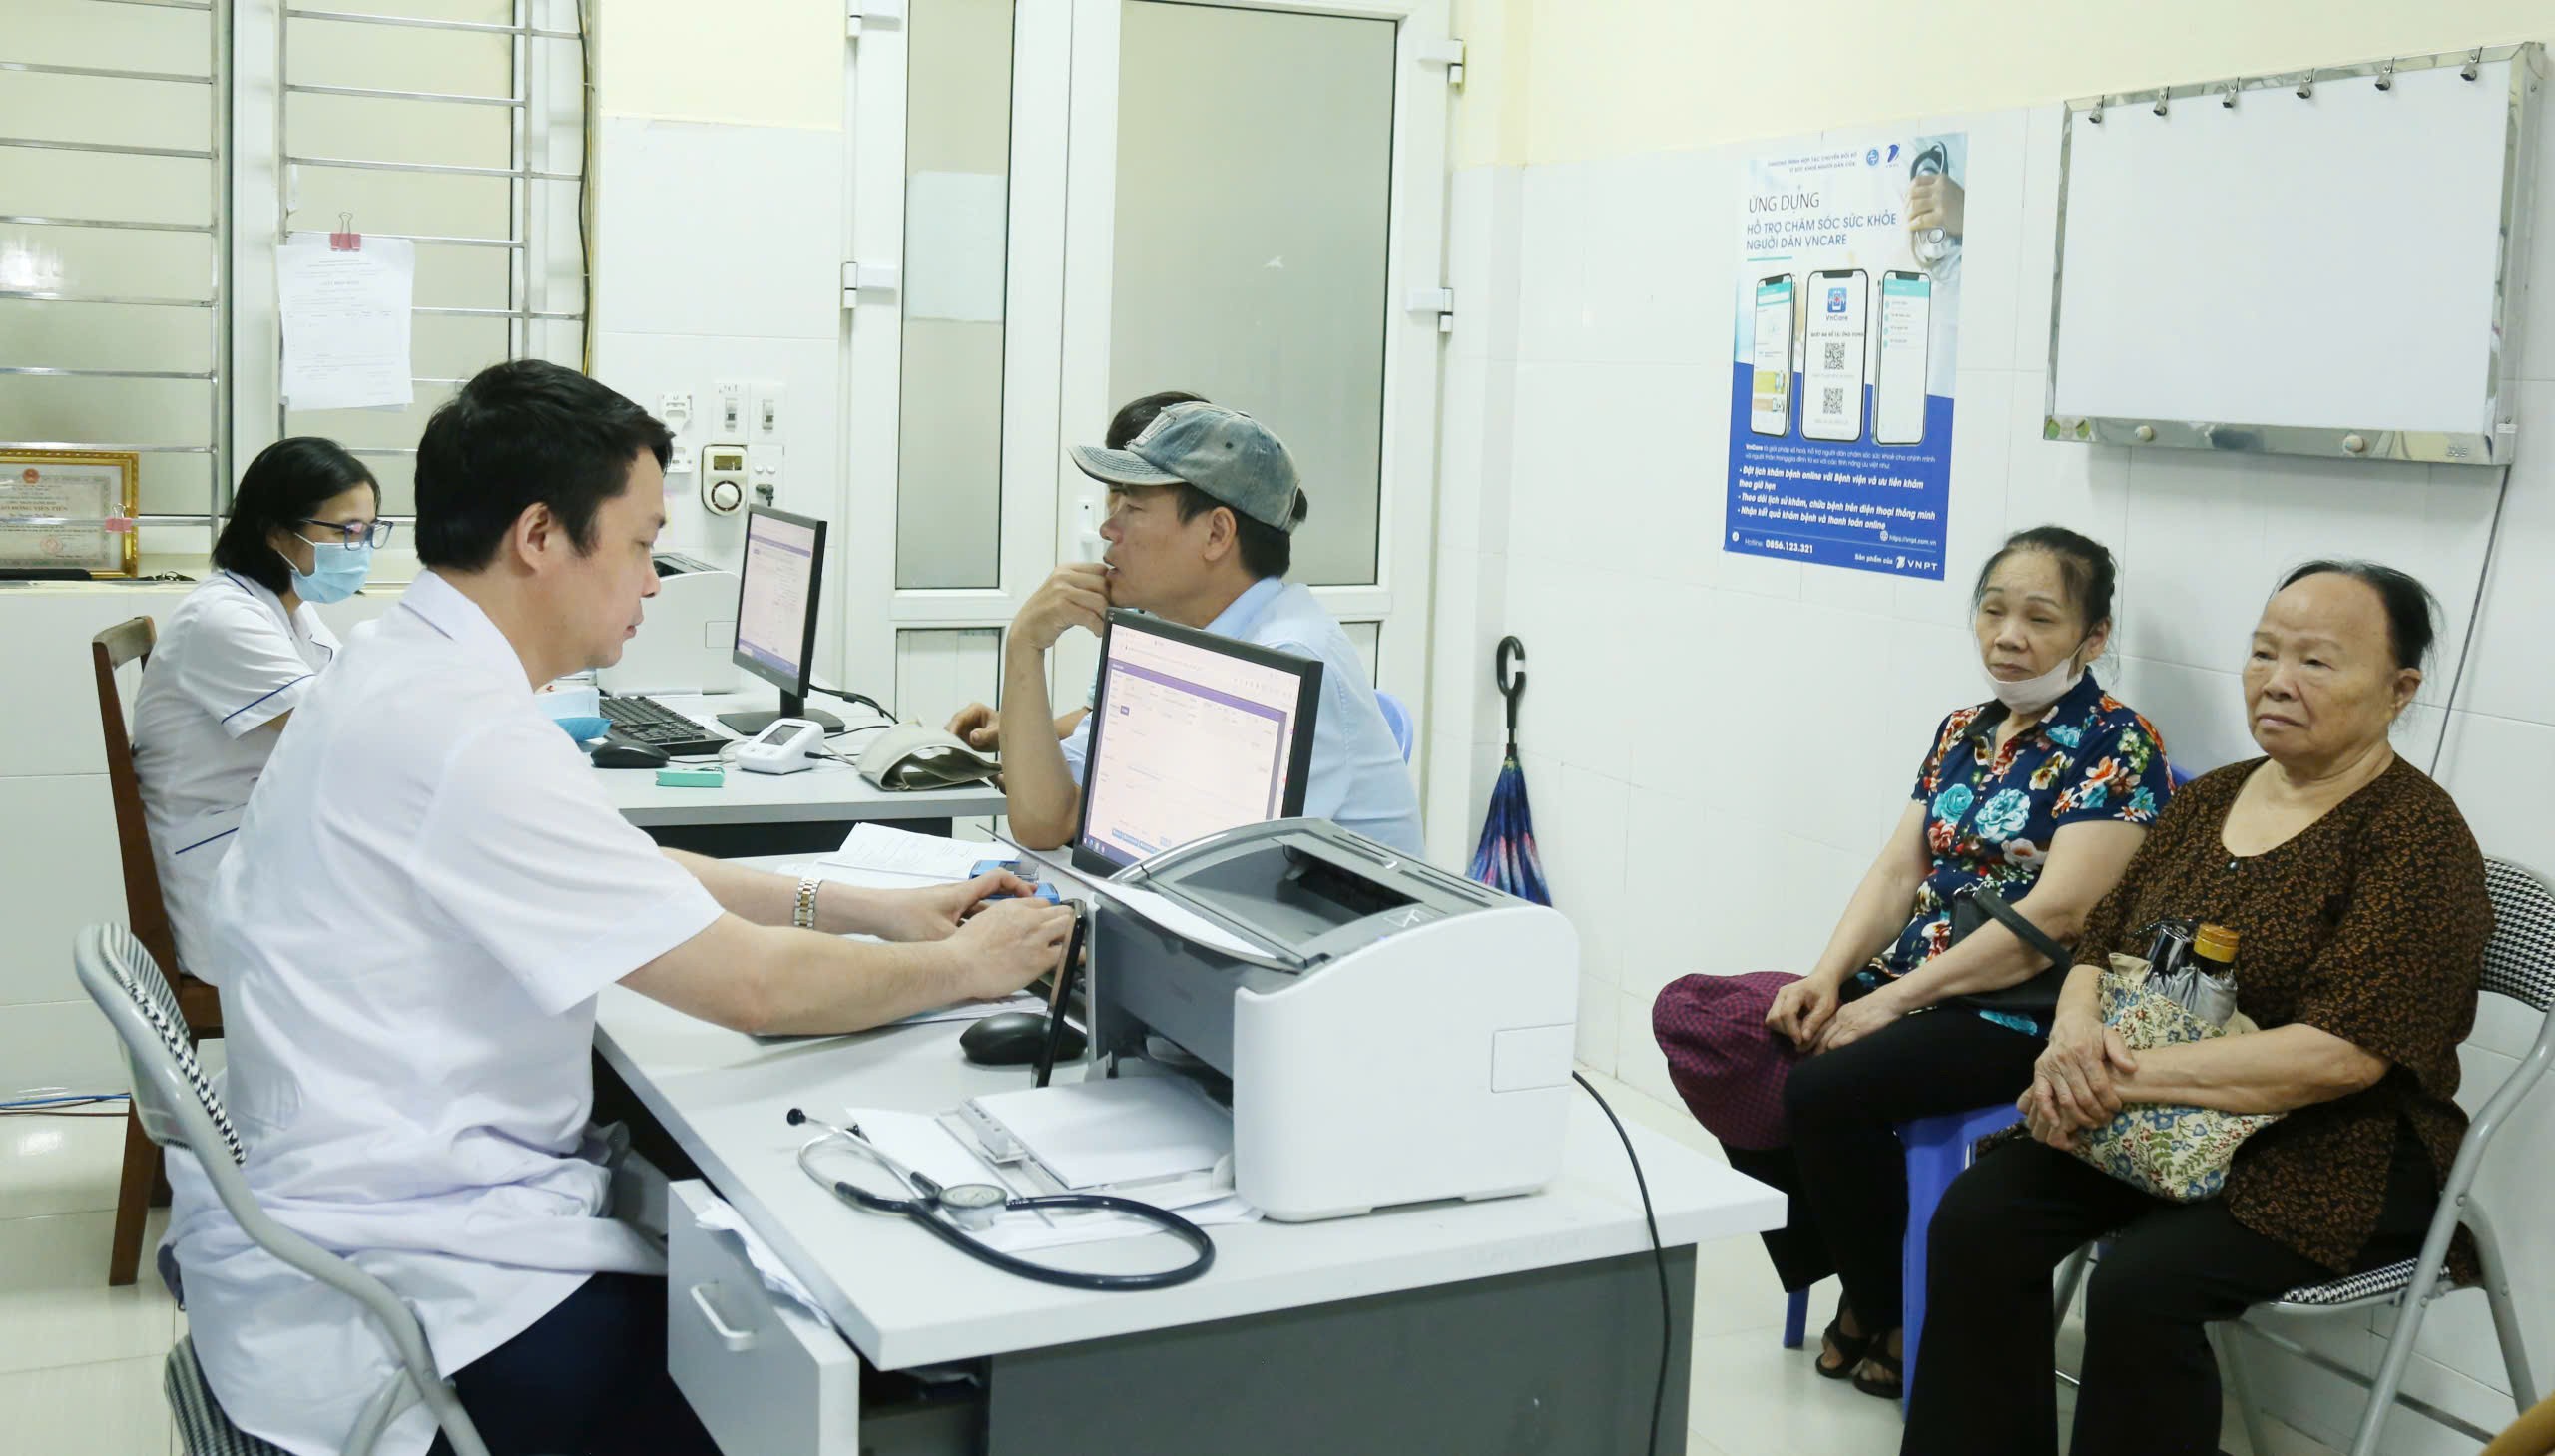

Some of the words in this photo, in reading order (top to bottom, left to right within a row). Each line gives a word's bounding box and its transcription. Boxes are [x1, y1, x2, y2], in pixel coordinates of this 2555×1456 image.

[1805, 234, 1847, 247] VNCARE
[1767, 467, 1784, 477] khám
[1785, 468, 1801, 479] bệnh
[1802, 470, 1821, 481] online
[1853, 474, 1867, 486] viện
[1903, 478, 1924, 489] khám
[1742, 492, 1756, 502] Theo
[1827, 501, 1844, 513] bệnh
[1845, 502, 1858, 513] trên
[1860, 503, 1875, 516] điện
[1917, 510, 1936, 520] minh
[1782, 510, 1799, 521] khám
[1801, 511, 1817, 523] bệnh
[1828, 515, 1847, 526] thanh
[1848, 517, 1864, 528] toán
[1865, 520, 1886, 530] online
[1765, 539, 1813, 554] 0856.123.321
[1907, 559, 1938, 571] VNPT
